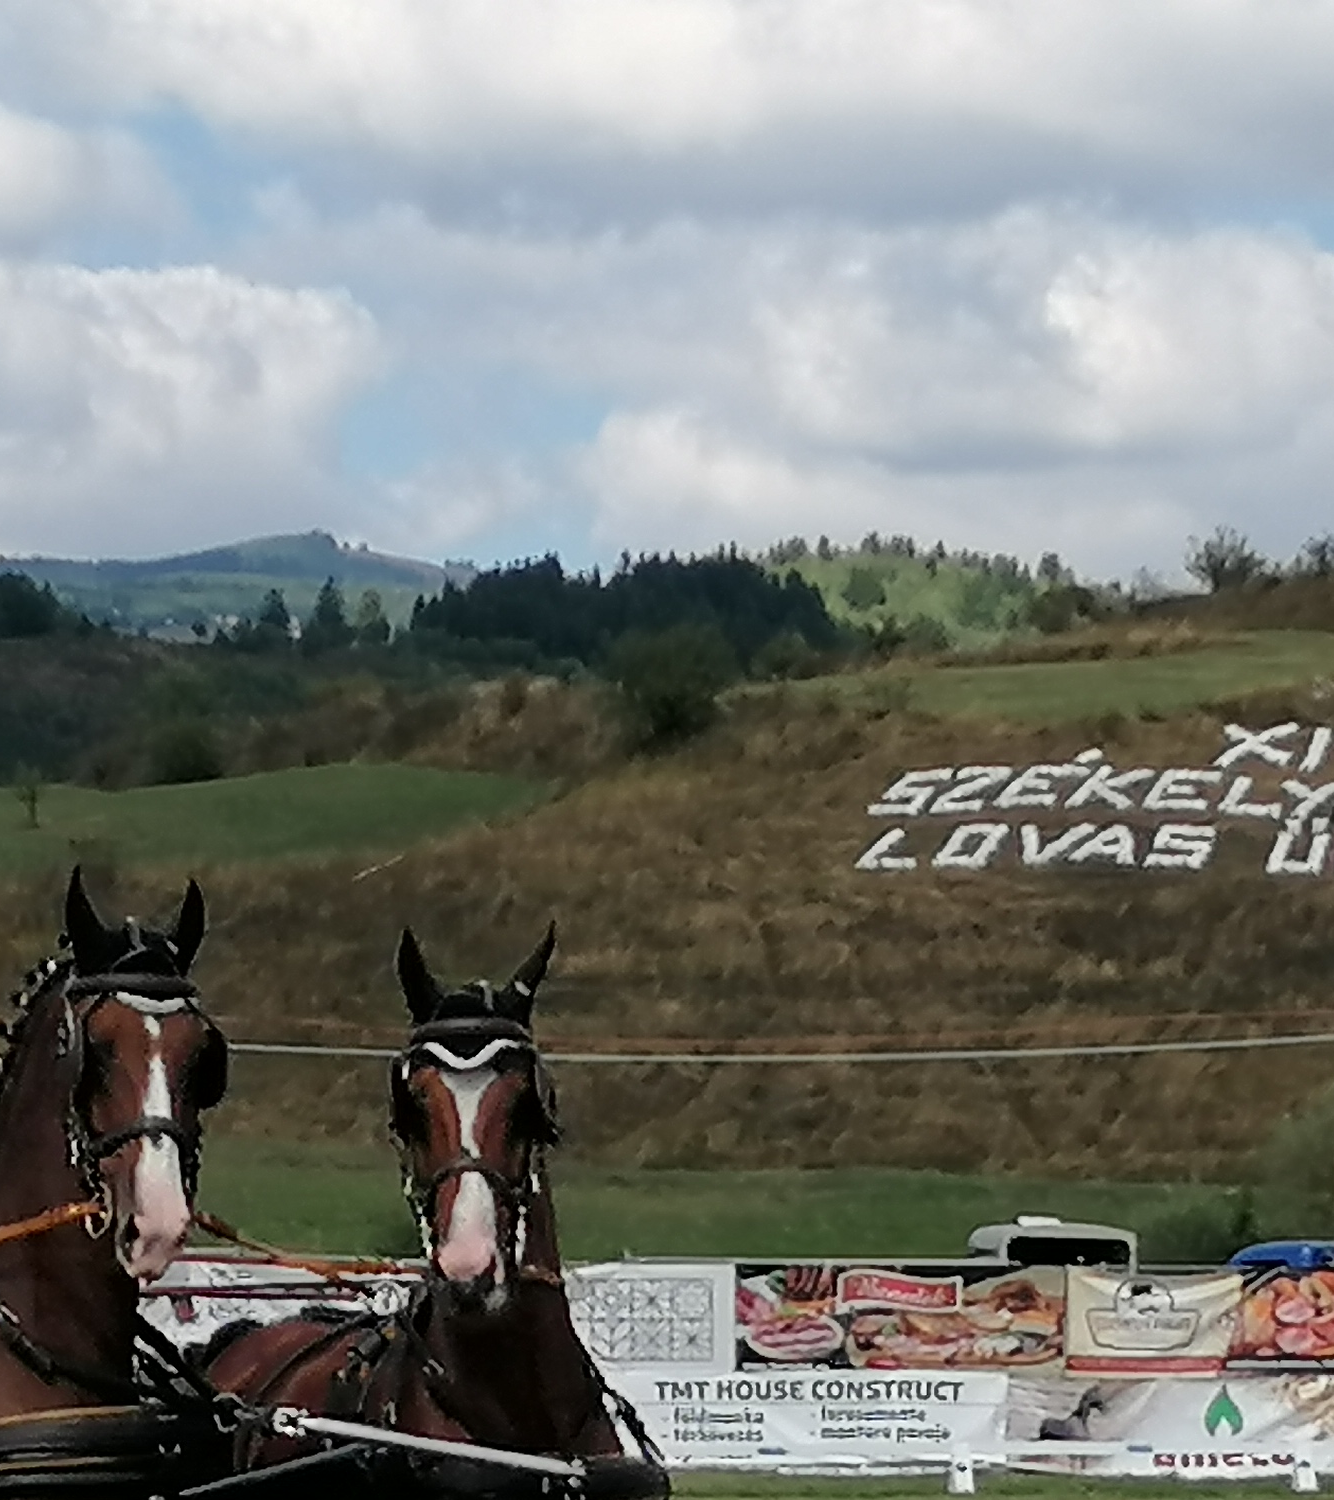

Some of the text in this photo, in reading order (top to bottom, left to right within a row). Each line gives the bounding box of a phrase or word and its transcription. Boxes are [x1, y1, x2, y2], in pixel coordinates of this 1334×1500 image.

[854, 822, 1218, 869] LOVAS
[654, 1379, 965, 1402] TMT HOUSE CONSTRUCT
